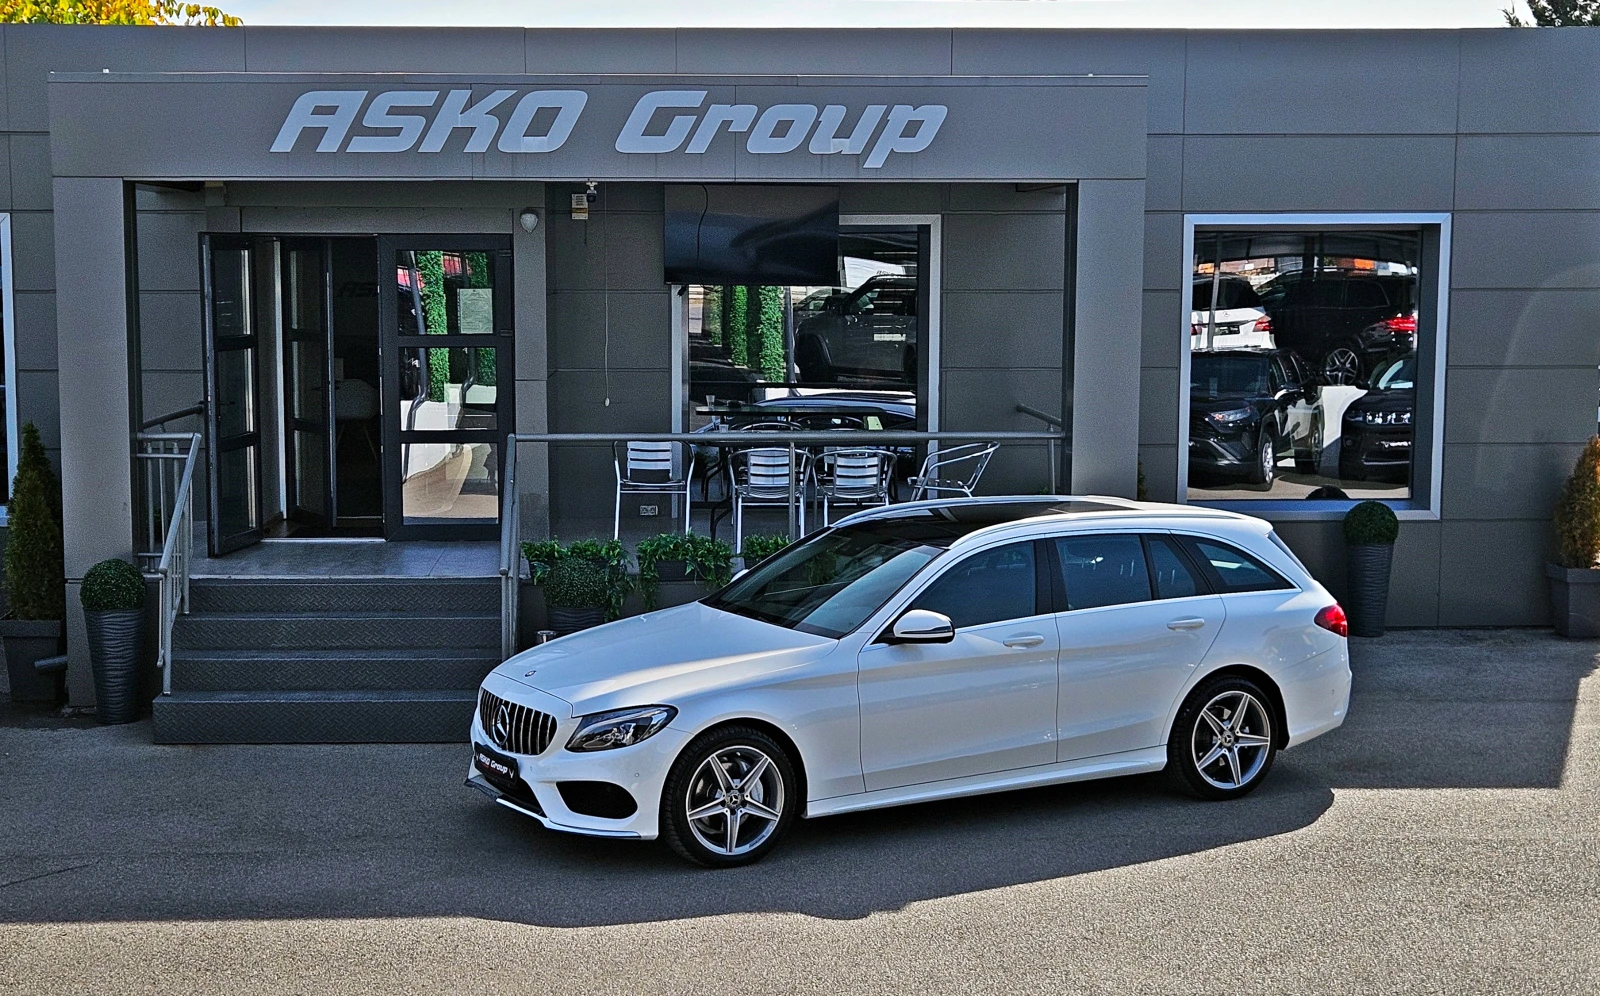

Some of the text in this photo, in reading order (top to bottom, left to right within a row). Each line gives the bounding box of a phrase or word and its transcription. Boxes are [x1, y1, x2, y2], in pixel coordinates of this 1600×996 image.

[270, 90, 948, 169] ASKO Group
[491, 760, 508, 774] Group
